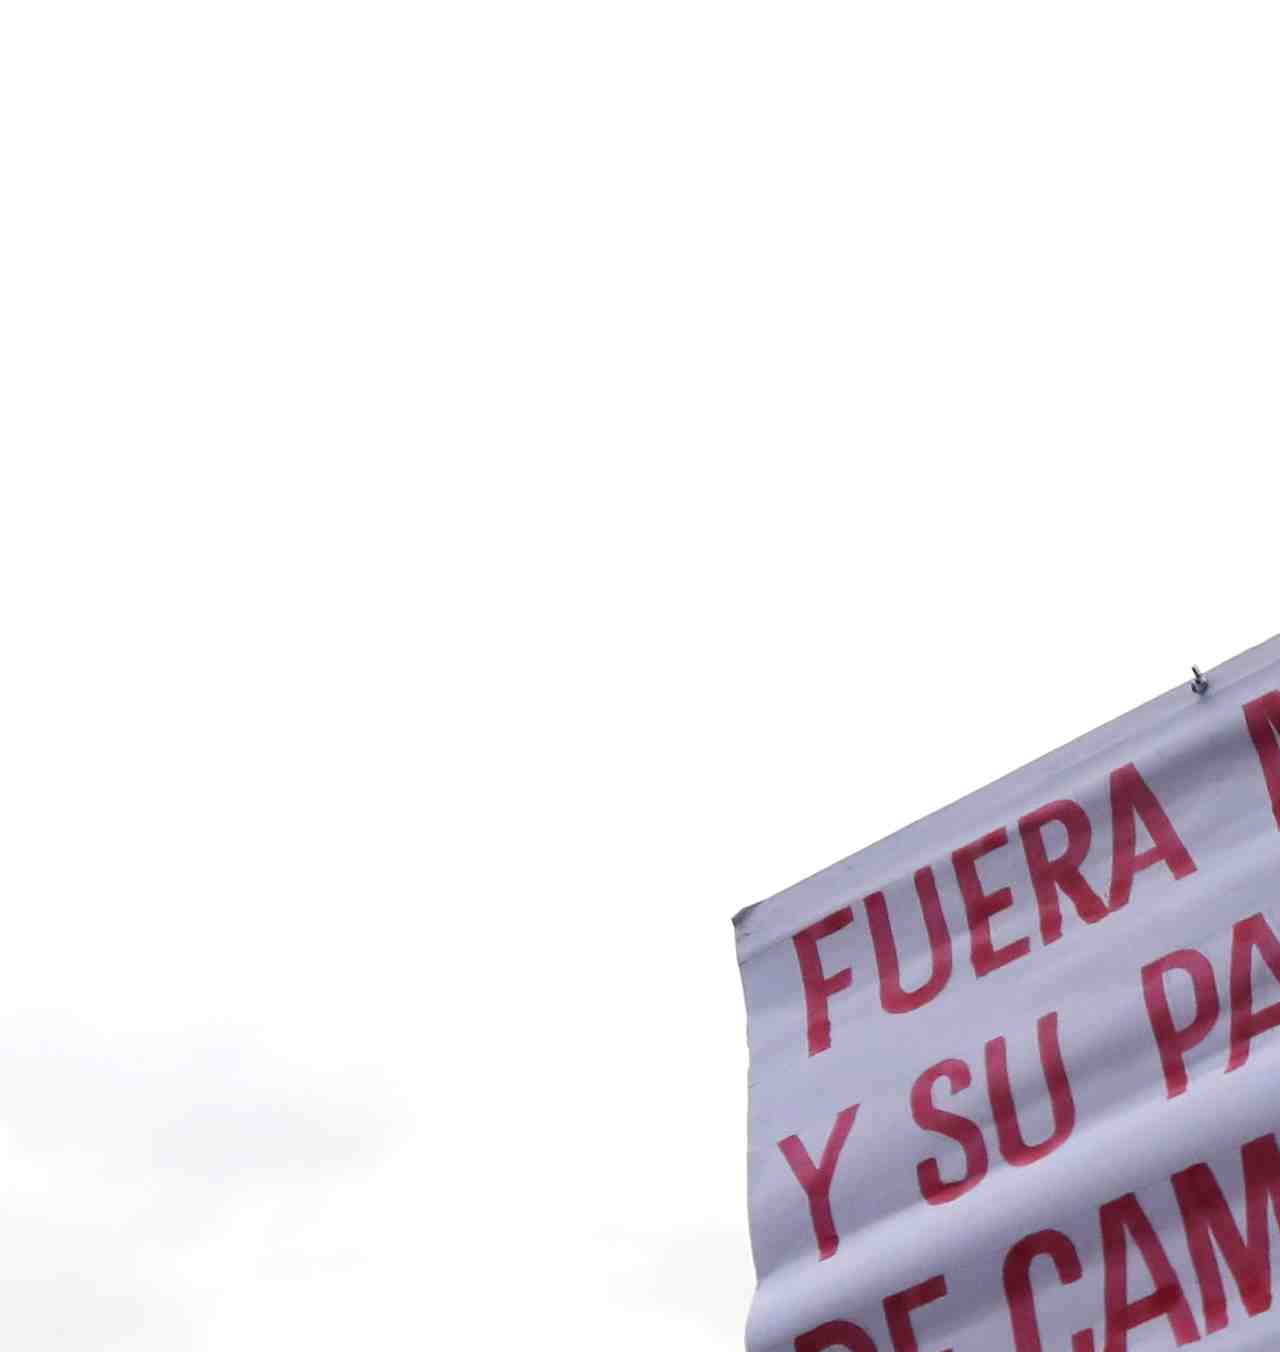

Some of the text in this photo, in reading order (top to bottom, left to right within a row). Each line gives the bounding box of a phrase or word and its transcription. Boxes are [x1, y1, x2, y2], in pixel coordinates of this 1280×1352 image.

[793, 763, 1196, 1057] FUERA
[779, 1103, 859, 1261] Y
[908, 1010, 1077, 1207] SU
